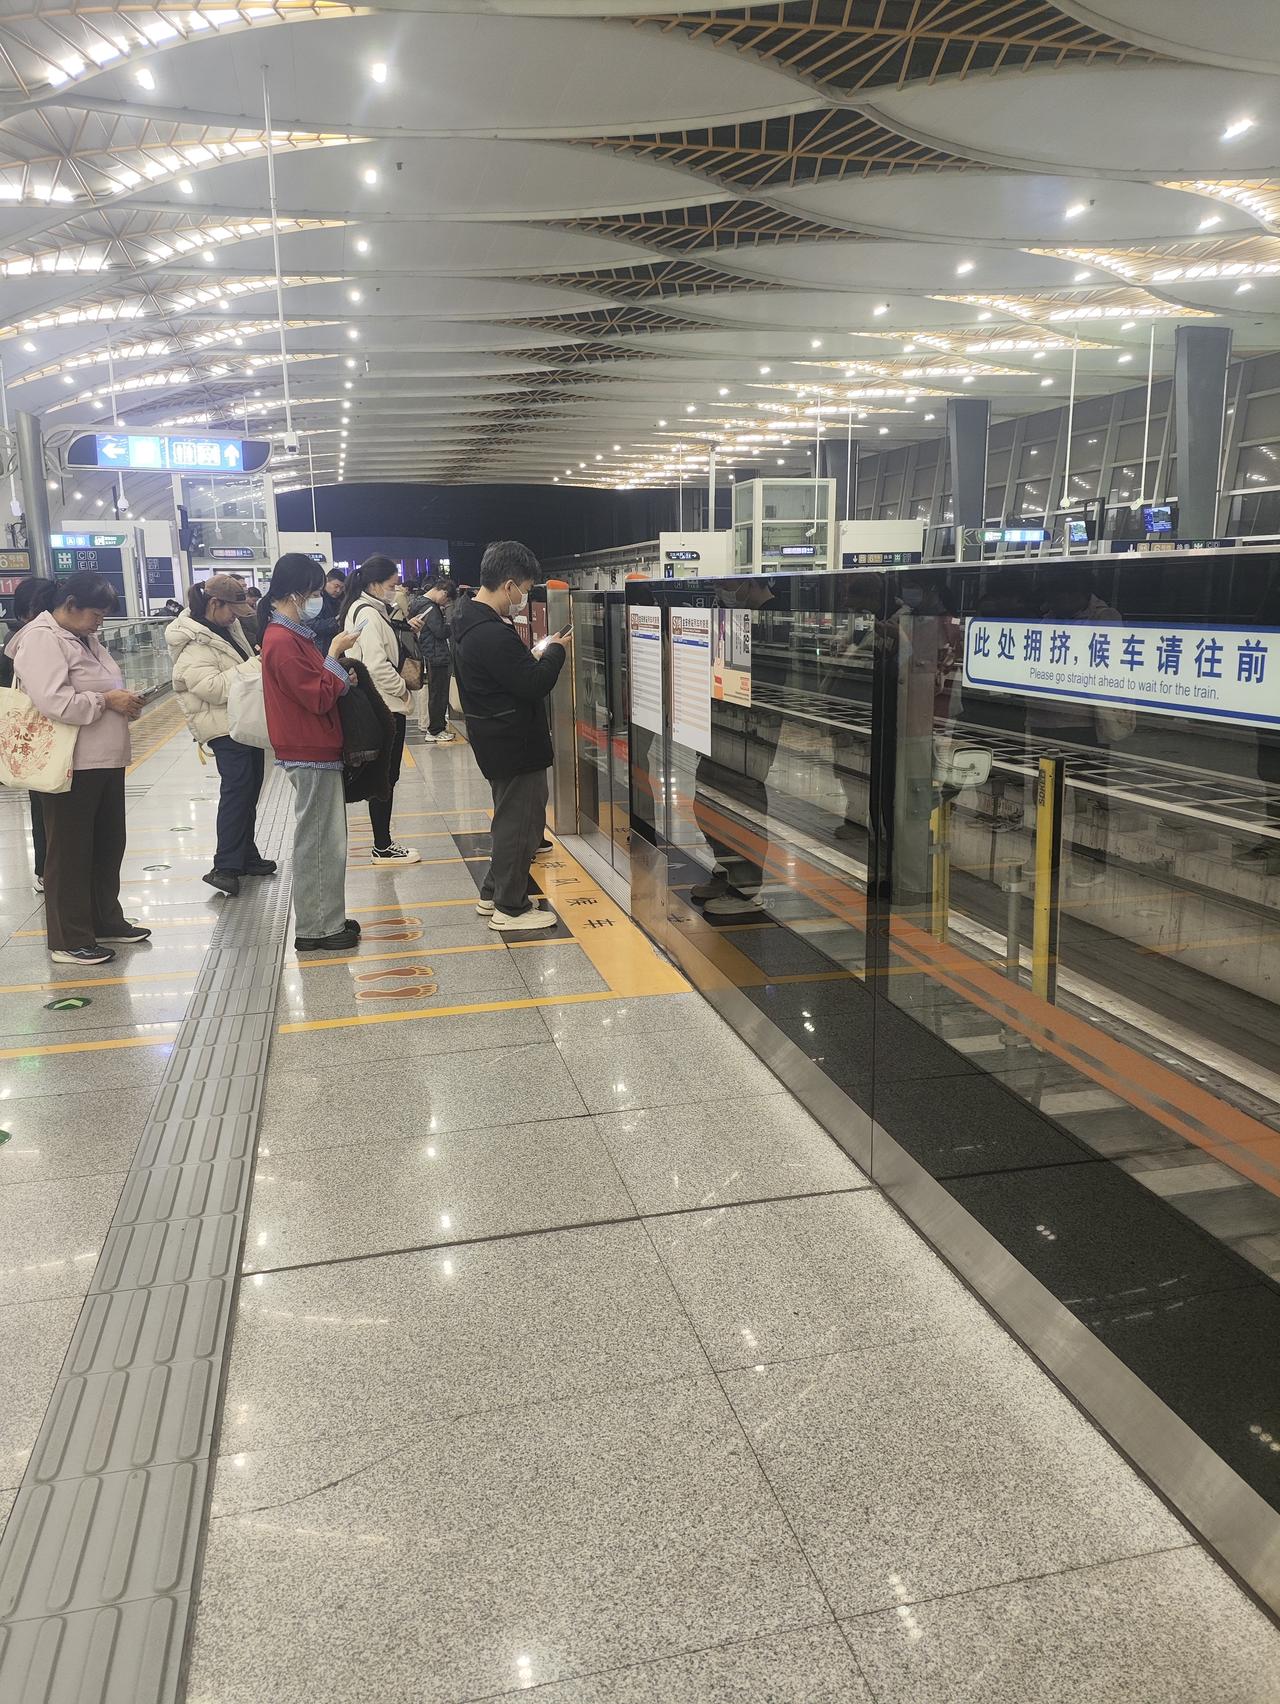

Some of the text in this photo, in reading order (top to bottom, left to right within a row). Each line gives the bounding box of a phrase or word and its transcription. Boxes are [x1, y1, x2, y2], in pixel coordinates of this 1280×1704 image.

[973, 627, 1269, 684] 此处拥挤，候车请往前
[1029, 667, 1220, 700] Please go straight ahead to wait for the train.
